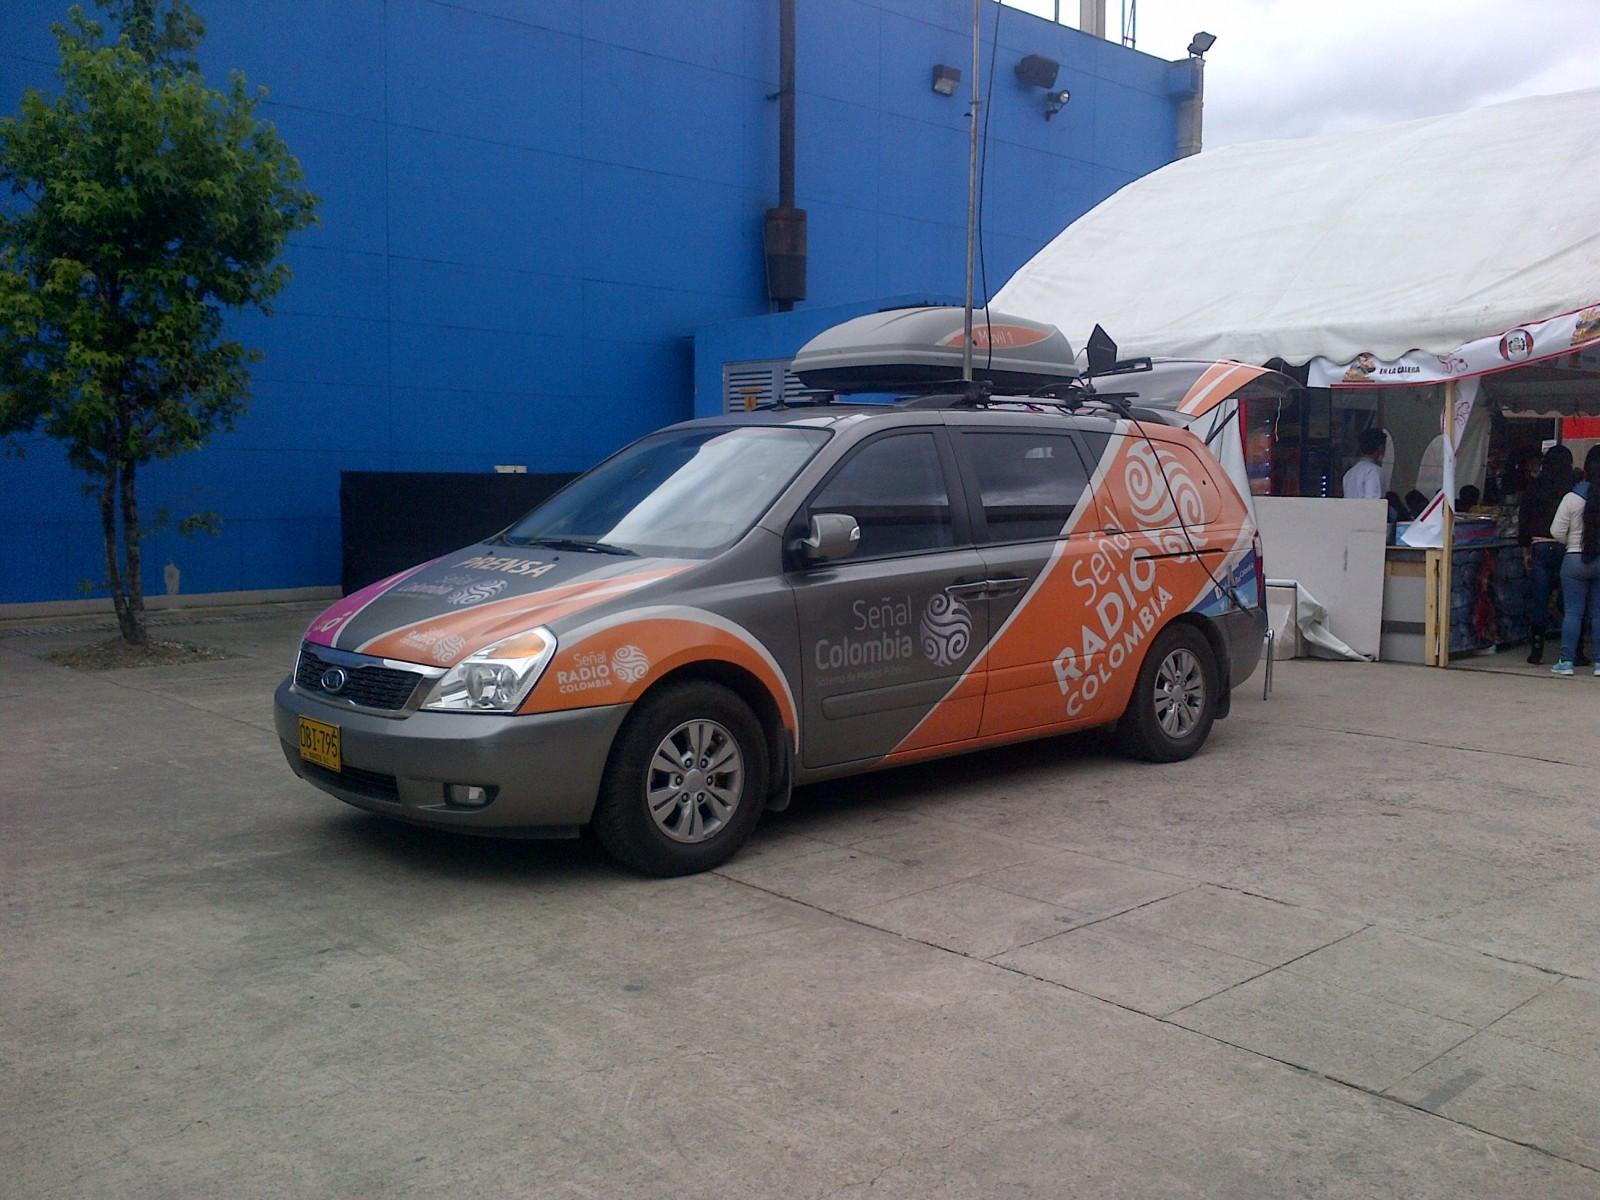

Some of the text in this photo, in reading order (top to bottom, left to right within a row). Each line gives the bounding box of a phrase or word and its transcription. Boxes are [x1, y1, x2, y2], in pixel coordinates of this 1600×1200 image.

[450, 556, 557, 578] PRENSA
[1071, 505, 1133, 606] Señal
[853, 594, 912, 631] Señal
[1052, 547, 1156, 696] RADIO
[572, 649, 608, 667] Señal
[814, 620, 913, 670] Colombia
[1066, 586, 1174, 717] COLOMBIA
[557, 664, 610, 685] RADIO
[559, 678, 613, 694] COLOMBIA
